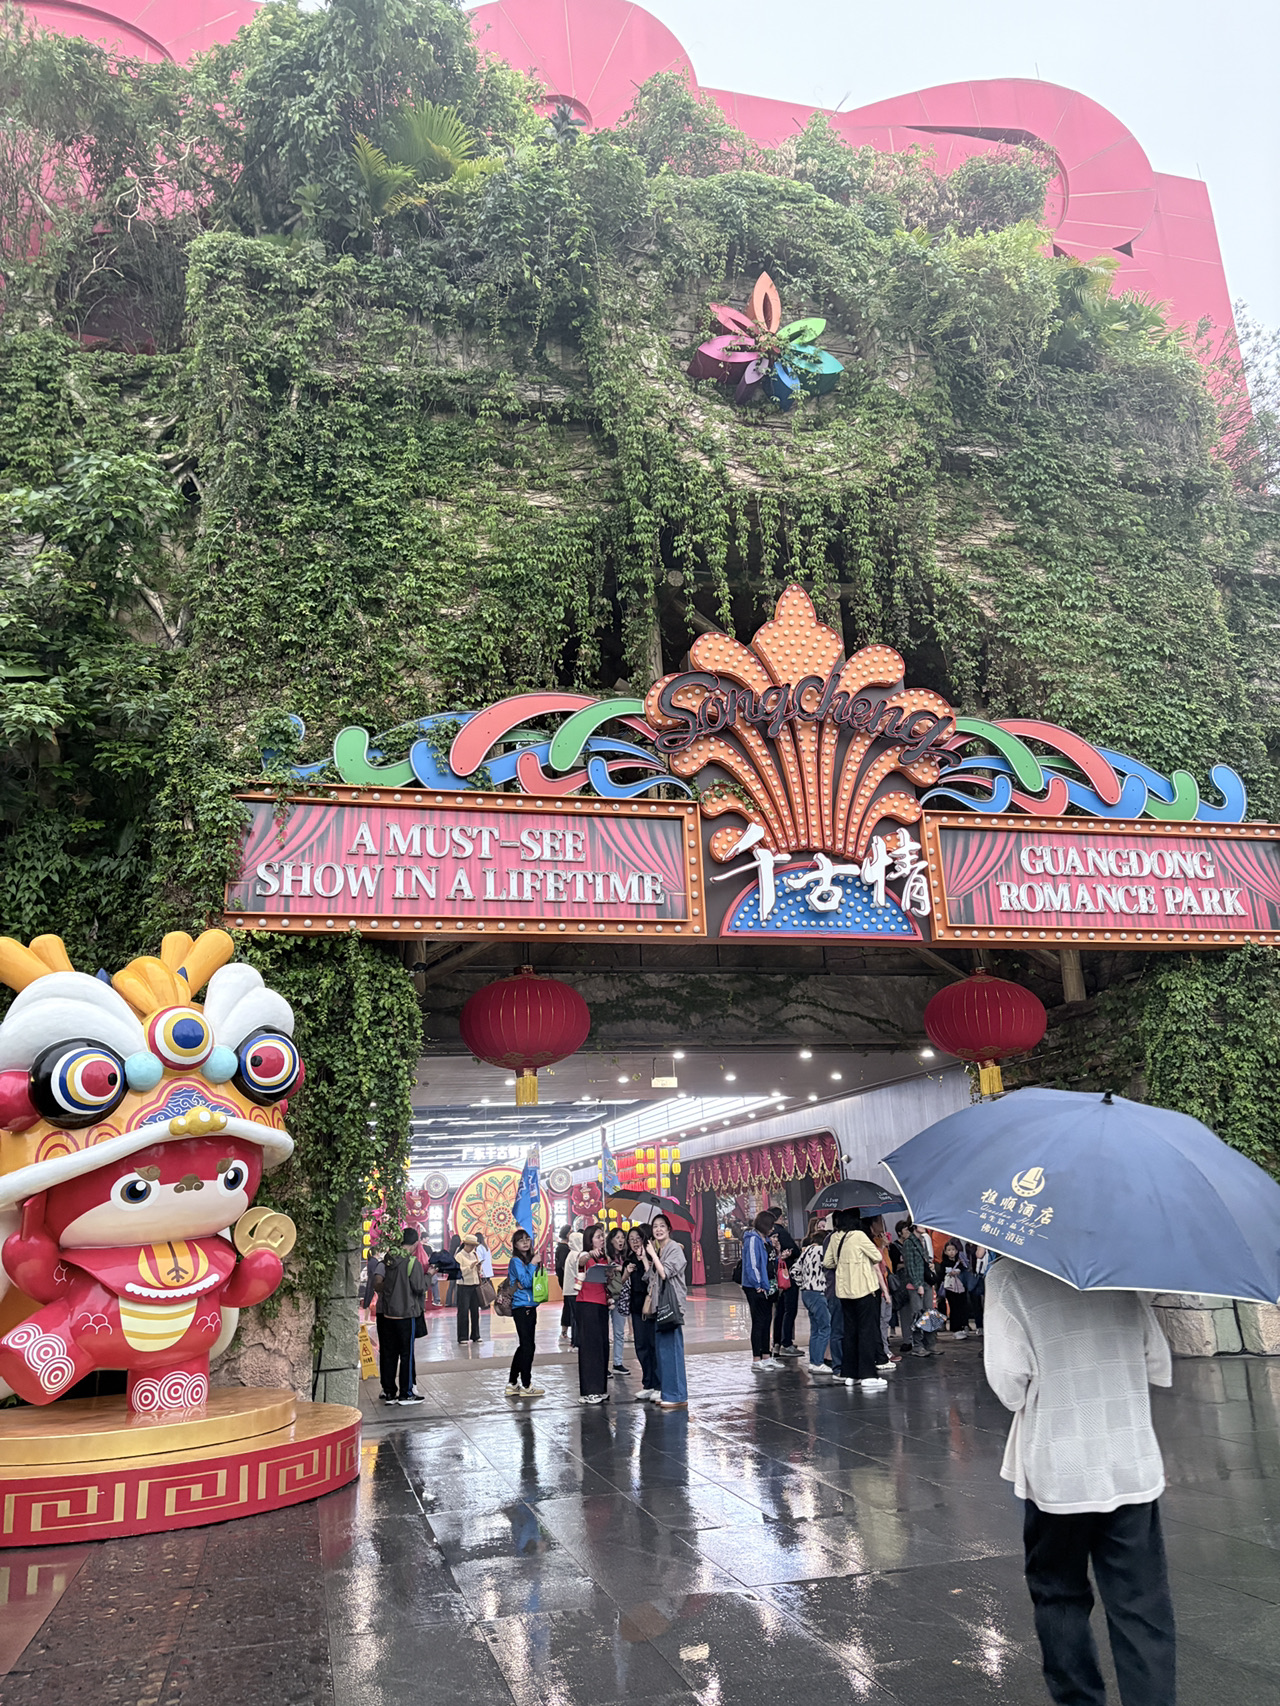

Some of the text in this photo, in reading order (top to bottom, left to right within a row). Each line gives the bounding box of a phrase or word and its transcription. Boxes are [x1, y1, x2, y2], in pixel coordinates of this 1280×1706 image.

[655, 671, 962, 767] Songcheng
[347, 821, 586, 863] A MUST-SEE
[1019, 844, 1216, 880] GUANGDONG
[255, 860, 666, 906] SHOW IN A LIFETIME
[710, 823, 931, 921] 千古情
[998, 881, 1249, 917] ROMANCE PARK
